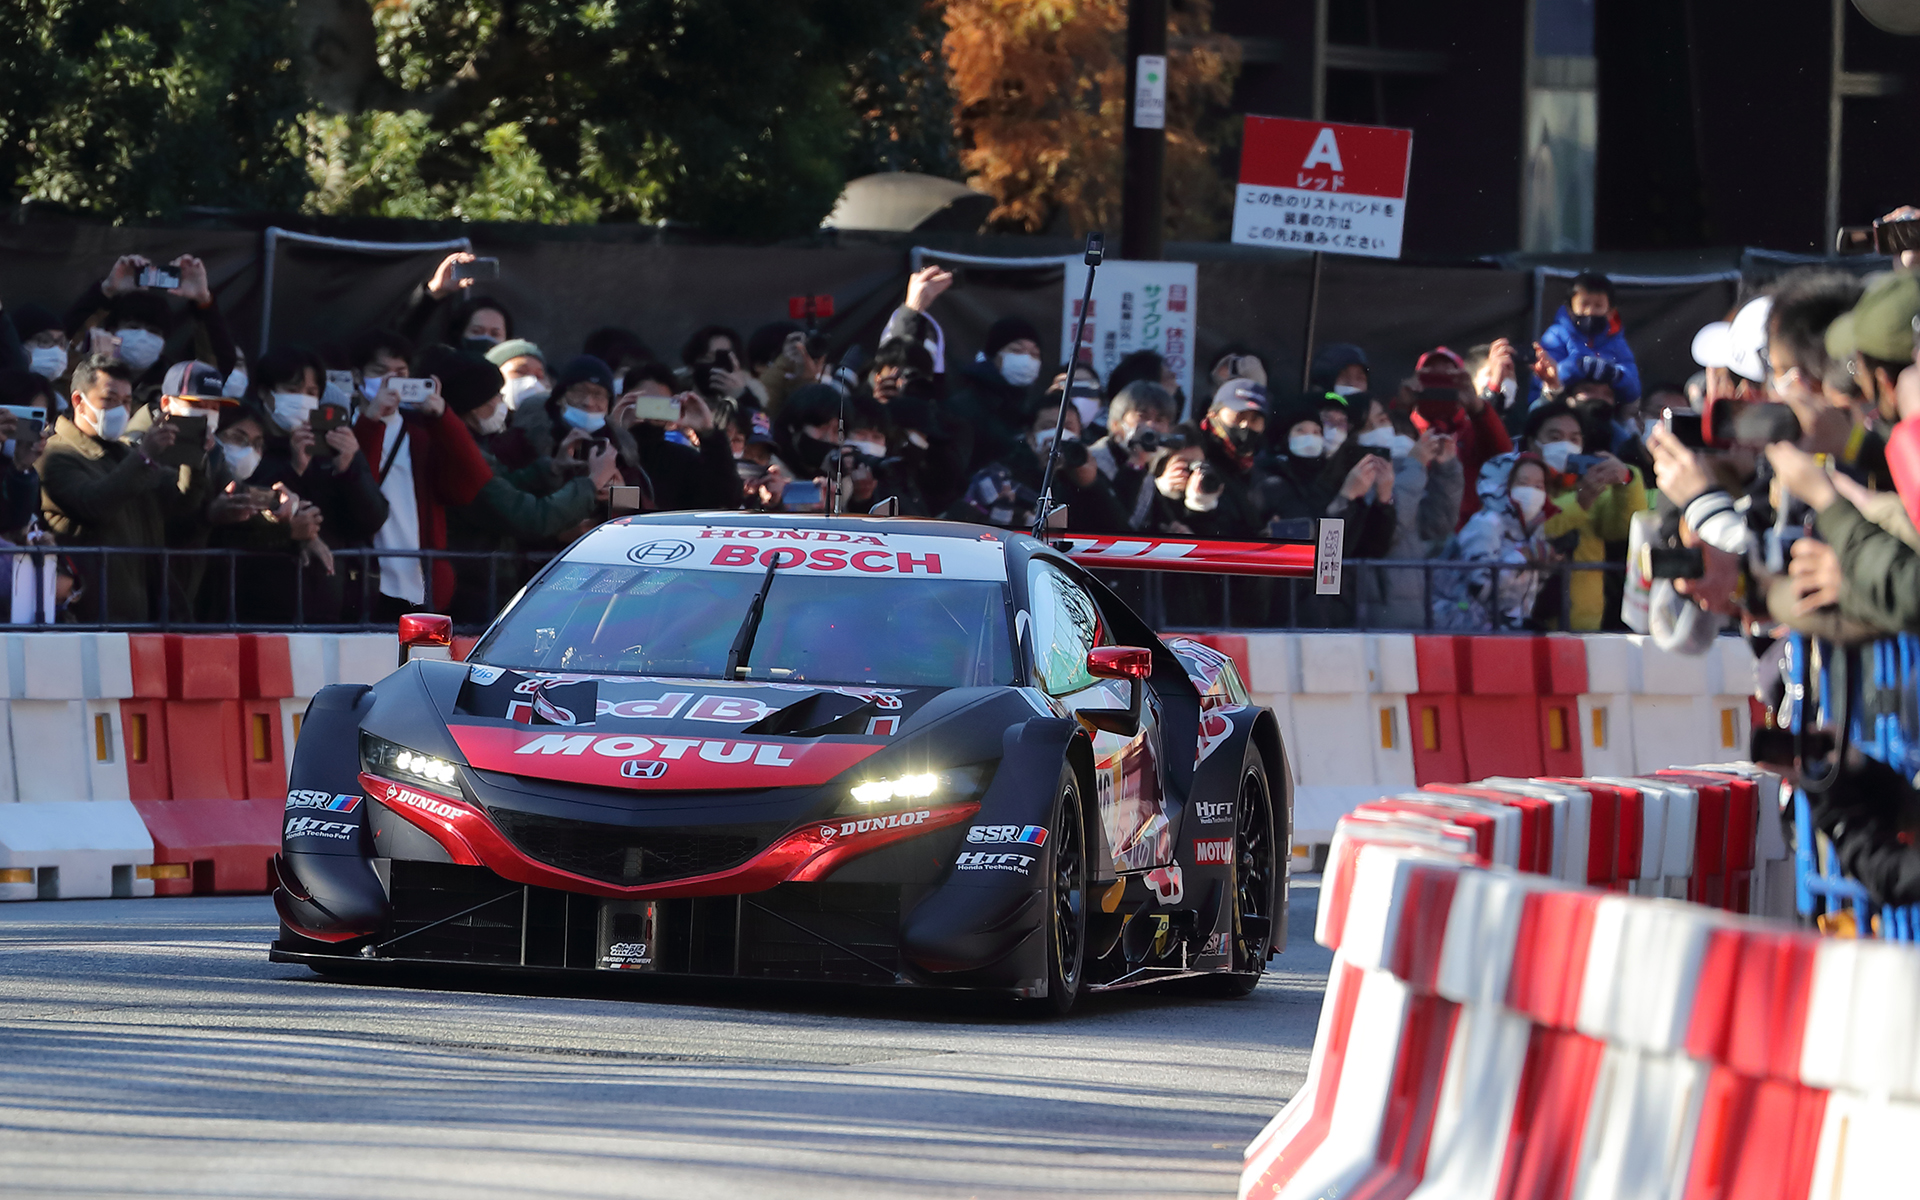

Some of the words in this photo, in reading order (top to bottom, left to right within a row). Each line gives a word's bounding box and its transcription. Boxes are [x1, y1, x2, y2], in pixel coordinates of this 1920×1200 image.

[1302, 127, 1344, 171] A
[1297, 172, 1345, 191] レッド
[1246, 193, 1394, 217] この色のリストバンドを
[1284, 211, 1352, 230] 装着の方は
[1248, 226, 1385, 249] この先お進みください
[1166, 284, 1188, 379] 日曜、休日の
[695, 528, 888, 547] HONDA
[709, 543, 943, 575] BOSCH
[514, 733, 794, 768] MOTUL
[285, 789, 331, 810] SSR
[395, 789, 464, 820] DUNLOP
[839, 810, 930, 836] DUNLOP
[966, 825, 1020, 844] SSR
